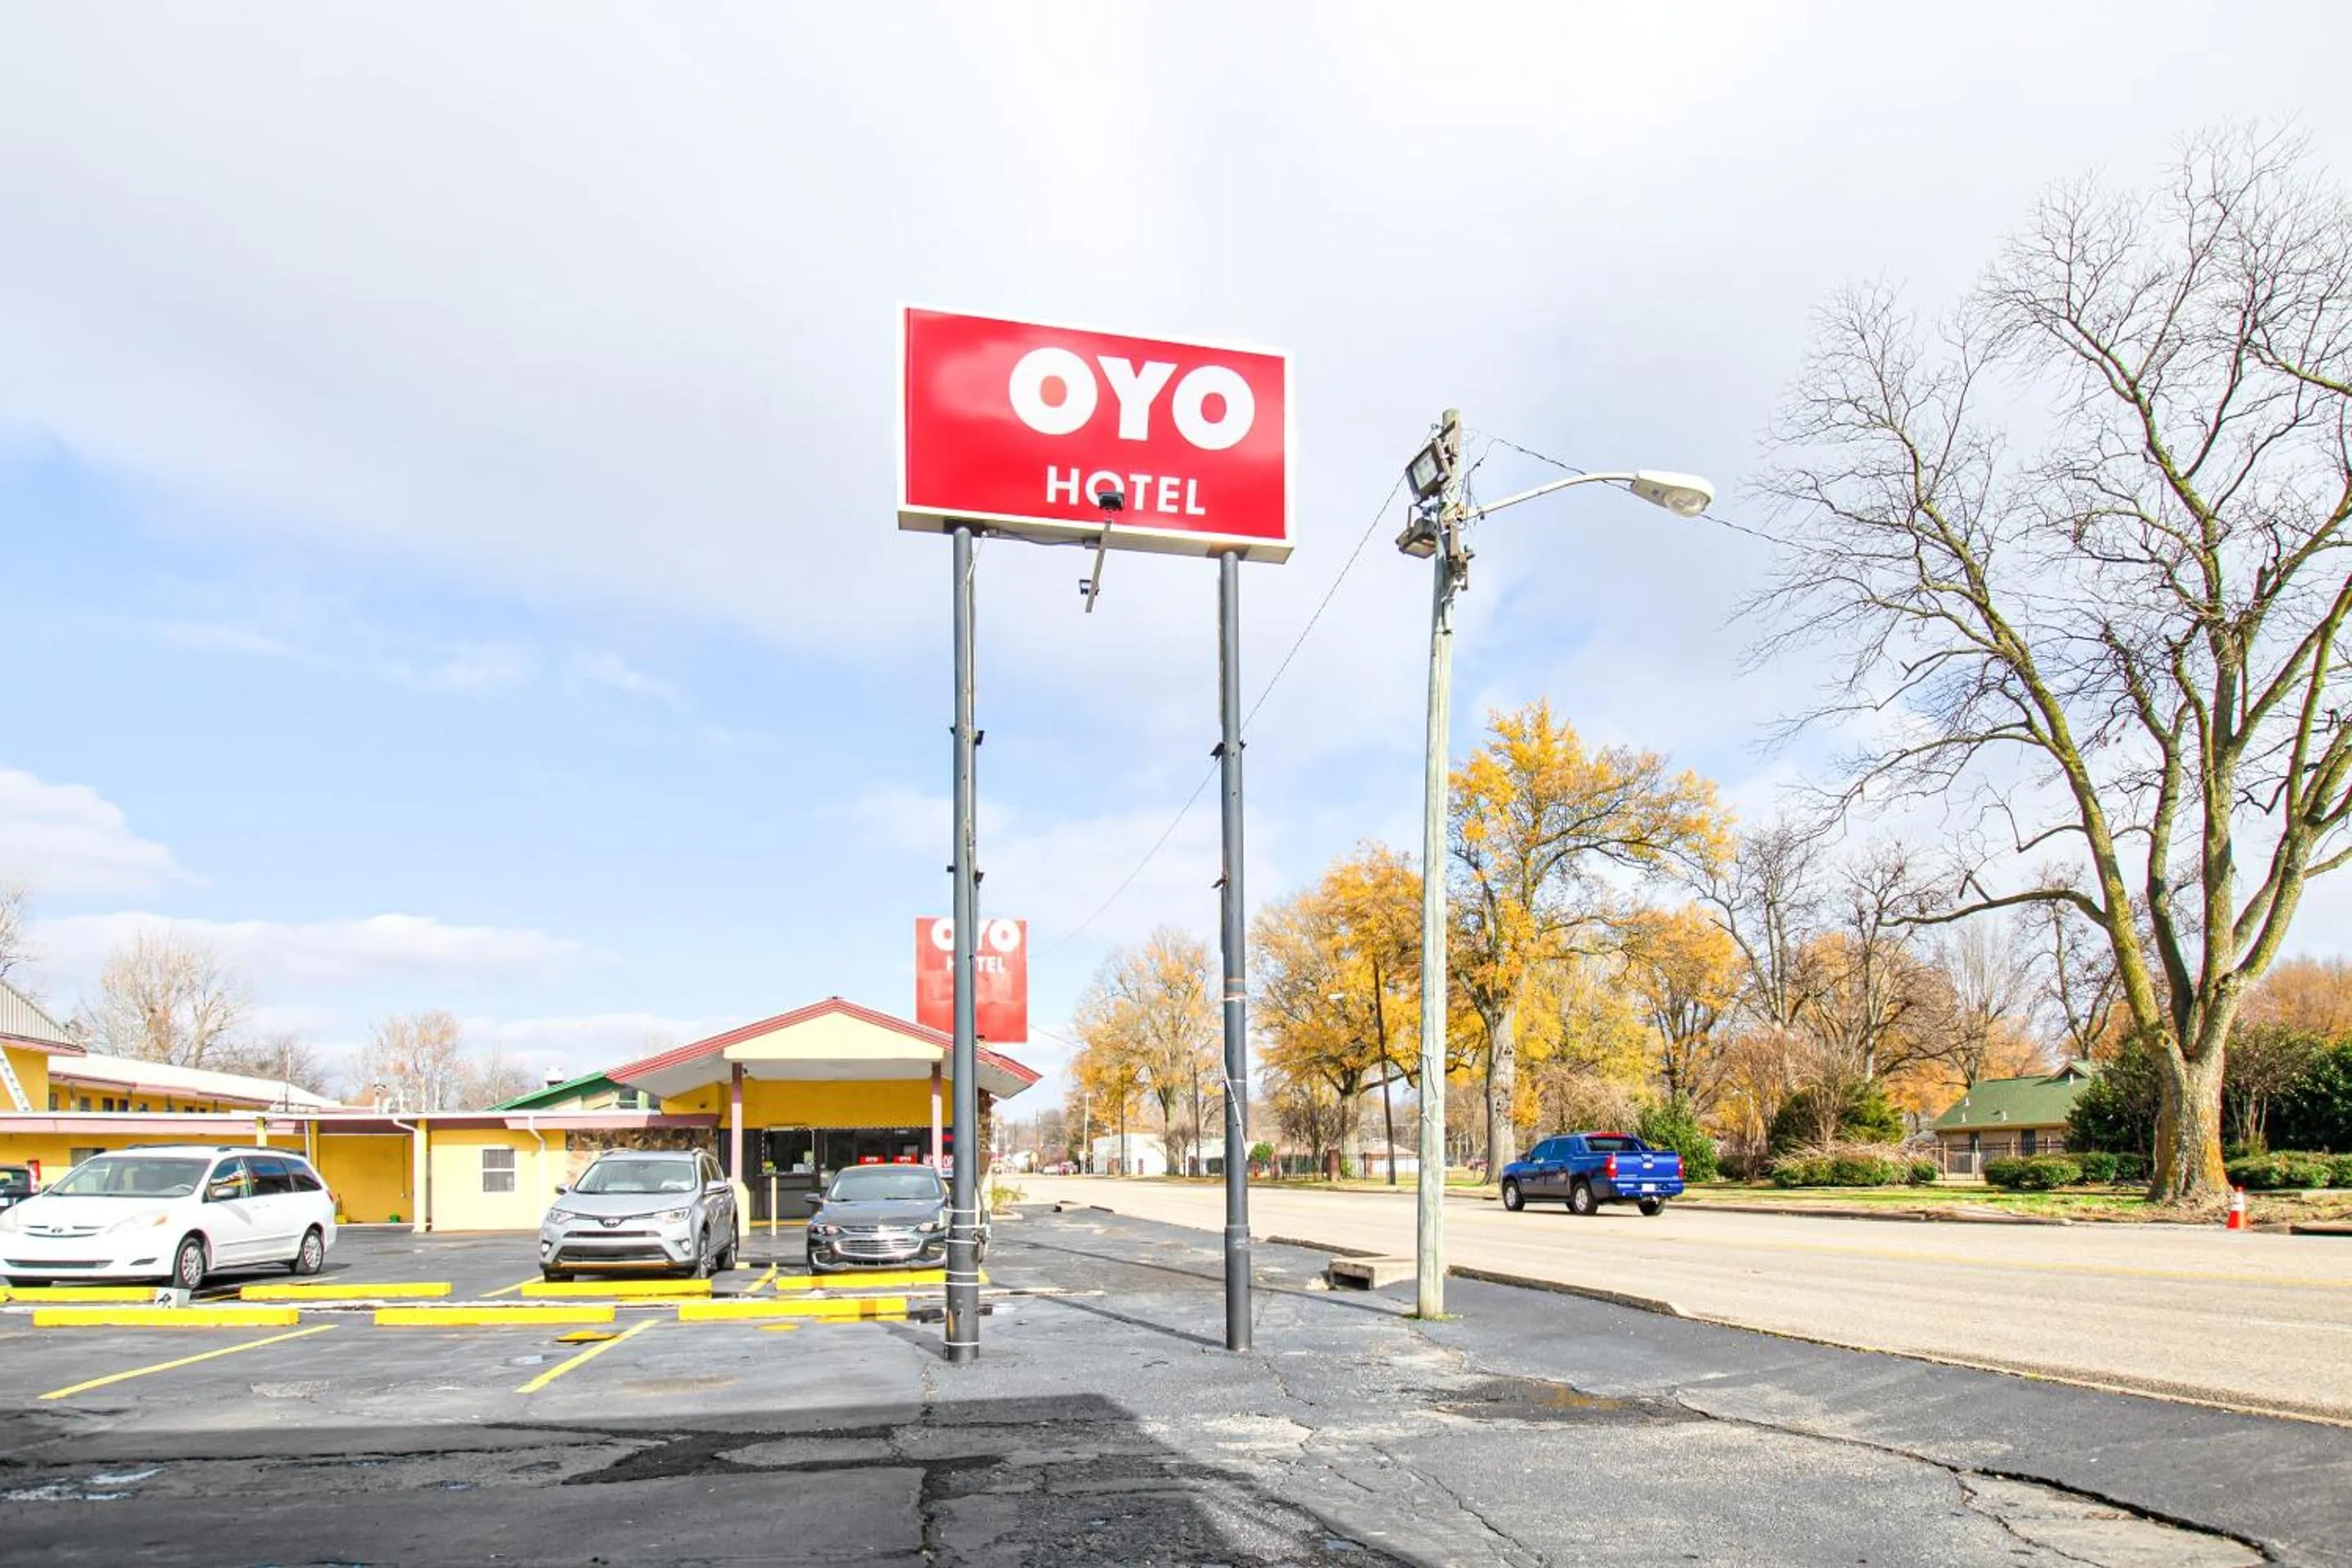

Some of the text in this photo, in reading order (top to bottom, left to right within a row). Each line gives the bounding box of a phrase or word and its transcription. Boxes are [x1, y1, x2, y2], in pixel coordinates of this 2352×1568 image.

[1009, 346, 1255, 450] OYO
[1046, 466, 1205, 515] HOTEL
[946, 956, 1006, 973] HTEL
